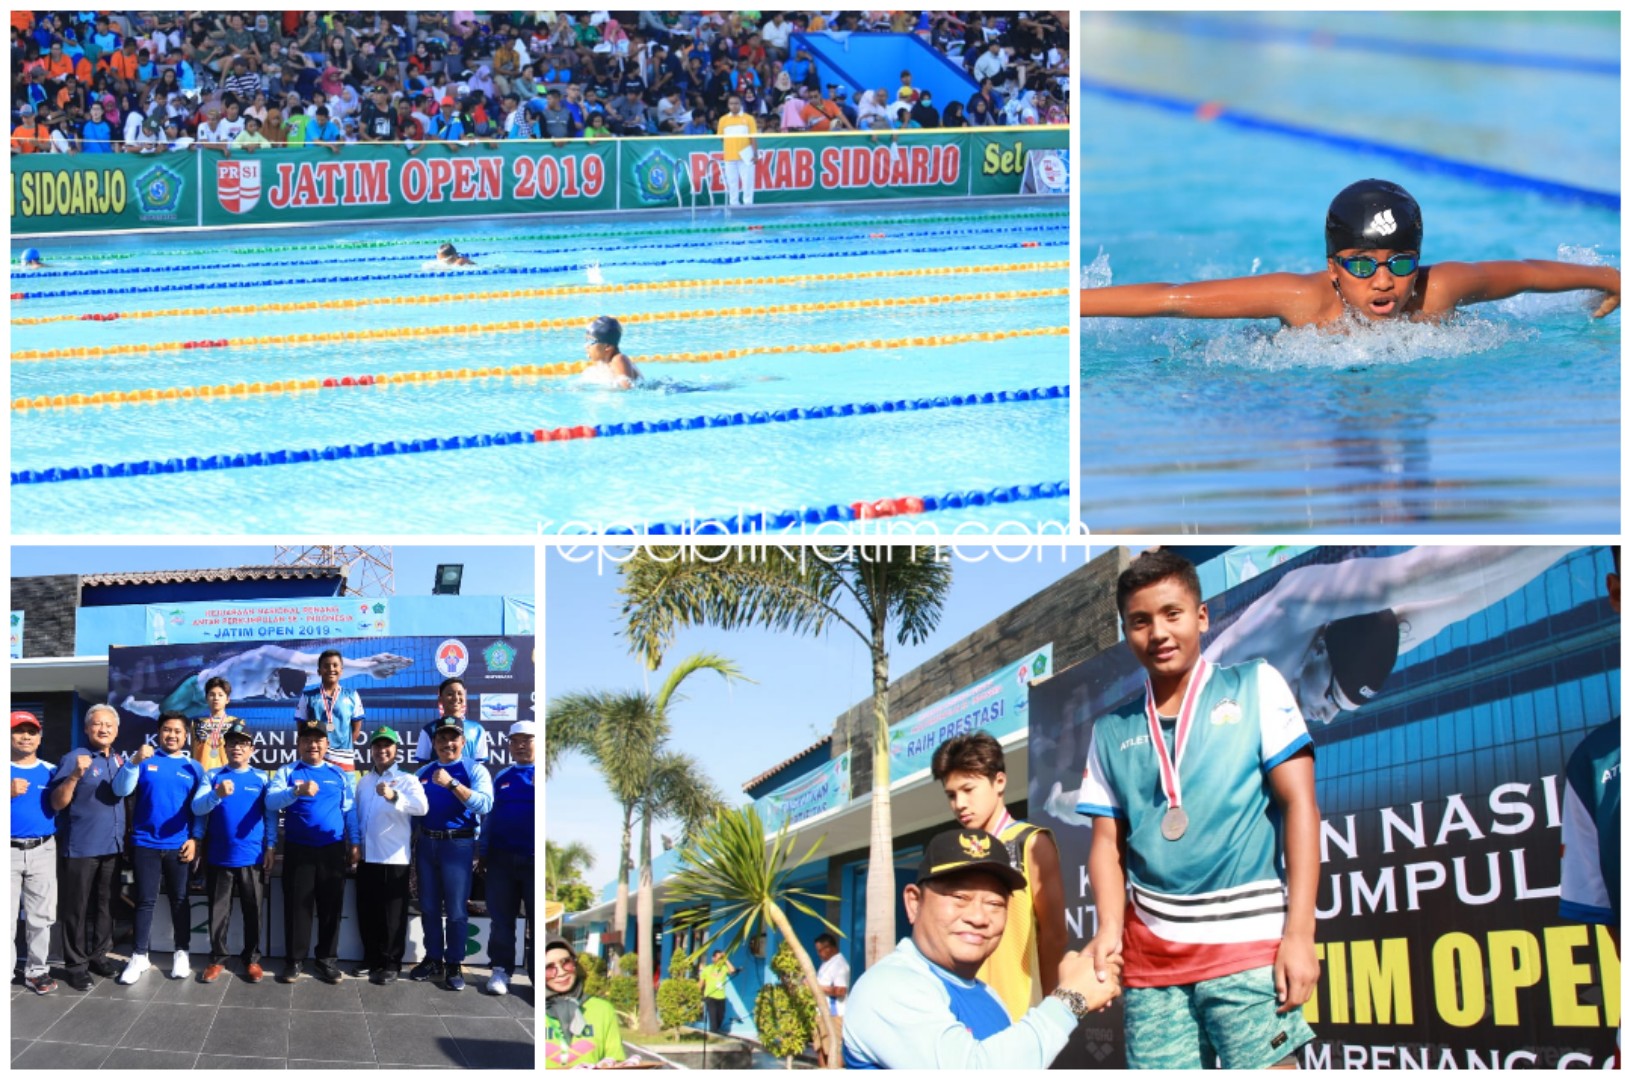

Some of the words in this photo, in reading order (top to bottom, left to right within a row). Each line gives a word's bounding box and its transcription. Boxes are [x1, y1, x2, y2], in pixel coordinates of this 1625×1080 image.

[269, 161, 391, 208] JATIM
[401, 157, 503, 203] OPEN
[513, 153, 604, 199] 2019
[820, 144, 960, 189] SIDOARJO
[982, 141, 1026, 175] Sel
[22, 169, 127, 216] SIDOARJO
[214, 627, 253, 638] JATIM
[258, 625, 294, 636] OPEN
[298, 624, 331, 635] 2019
[907, 730, 935, 758] RAIH
[938, 698, 1005, 744] PRESTASI
[1120, 735, 1149, 751] ATLET
